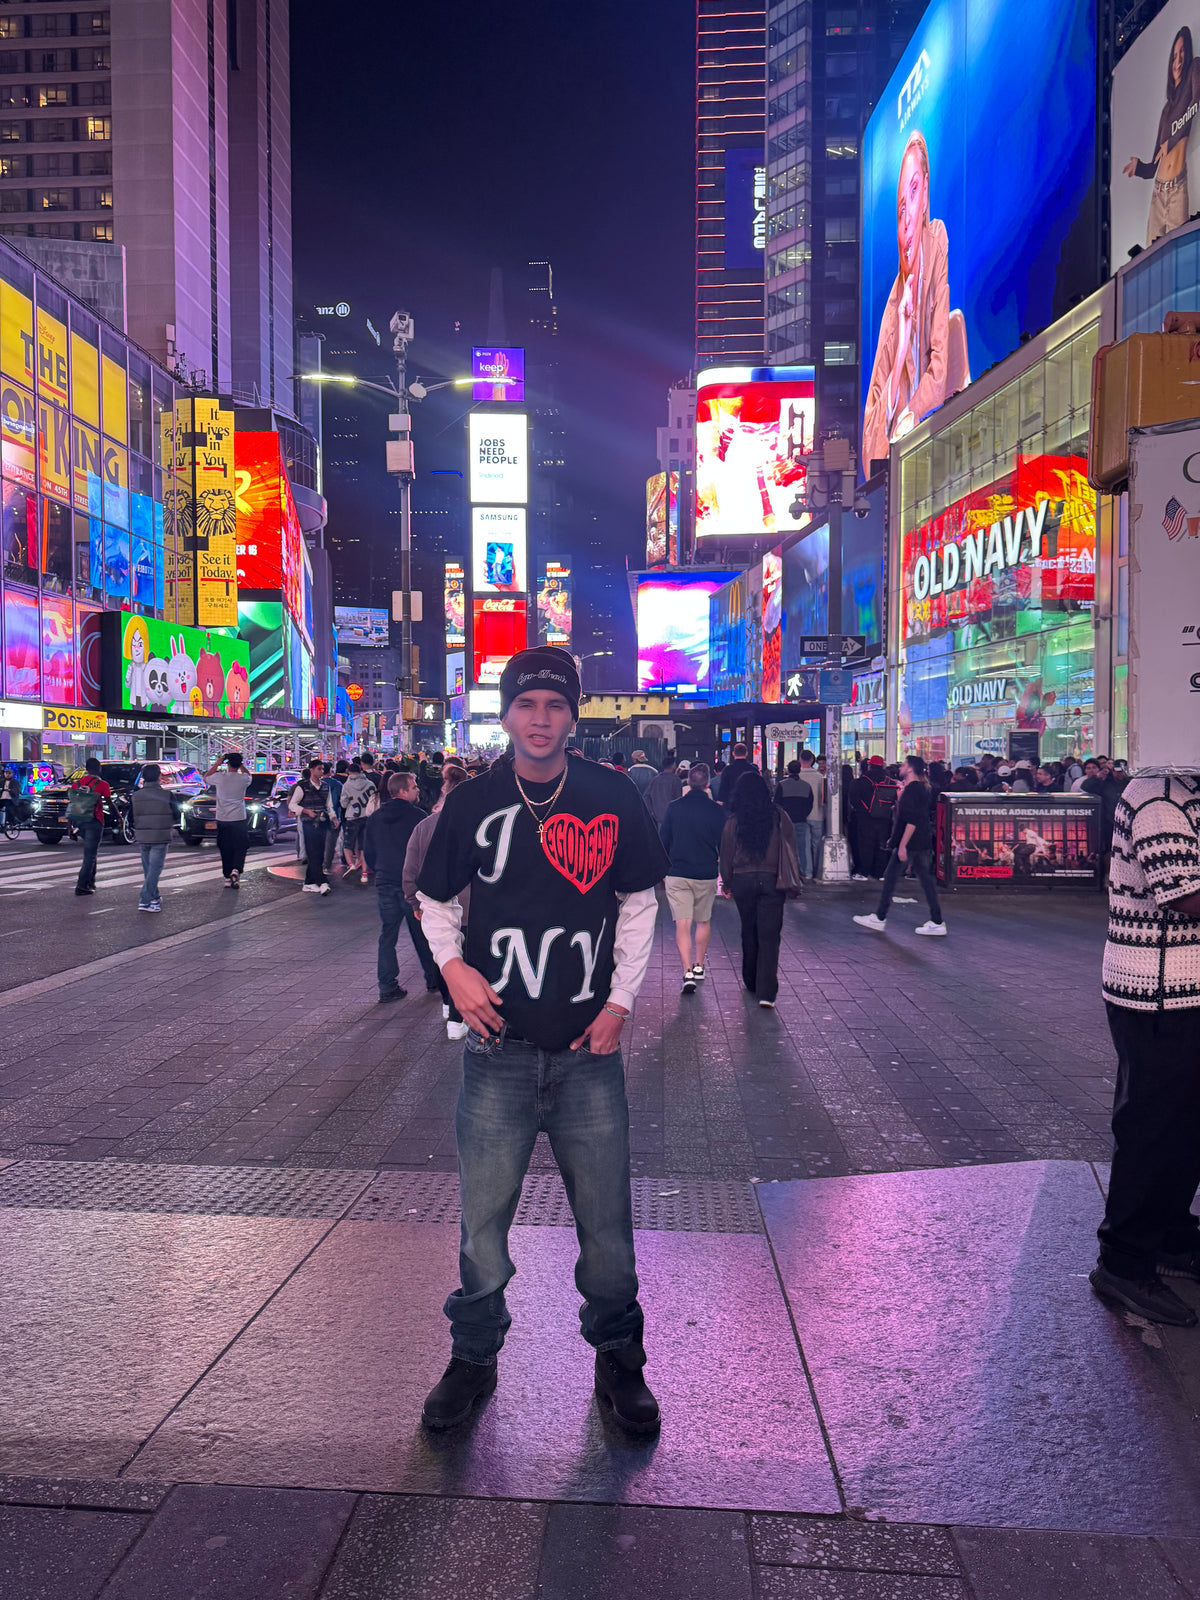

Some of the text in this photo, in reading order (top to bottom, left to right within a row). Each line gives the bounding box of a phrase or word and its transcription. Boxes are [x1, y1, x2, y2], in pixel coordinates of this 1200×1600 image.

[900, 73, 930, 134] AIRWAYS
[1171, 102, 1198, 136] Denim
[20, 329, 67, 391] THE
[479, 362, 504, 375] keep
[210, 407, 219, 421] It
[200, 422, 230, 436] Lives
[53, 397, 120, 485] KING
[209, 437, 220, 451] in
[479, 438, 505, 447] JOBS
[479, 447, 505, 456] NEED
[202, 452, 225, 467] You
[479, 456, 518, 464] PEOPLE
[480, 513, 518, 521] SAMSUNG
[914, 542, 960, 600] OLD
[964, 499, 1050, 583] NAVY
[202, 553, 231, 566] See it
[200, 566, 234, 579] Today.
[809, 641, 828, 651] ONE
[951, 678, 1007, 705] OLD NAVY
[965, 808, 1007, 816] RIVETING
[1008, 808, 1065, 816] ADRENALINE
[489, 917, 607, 1004] NY
